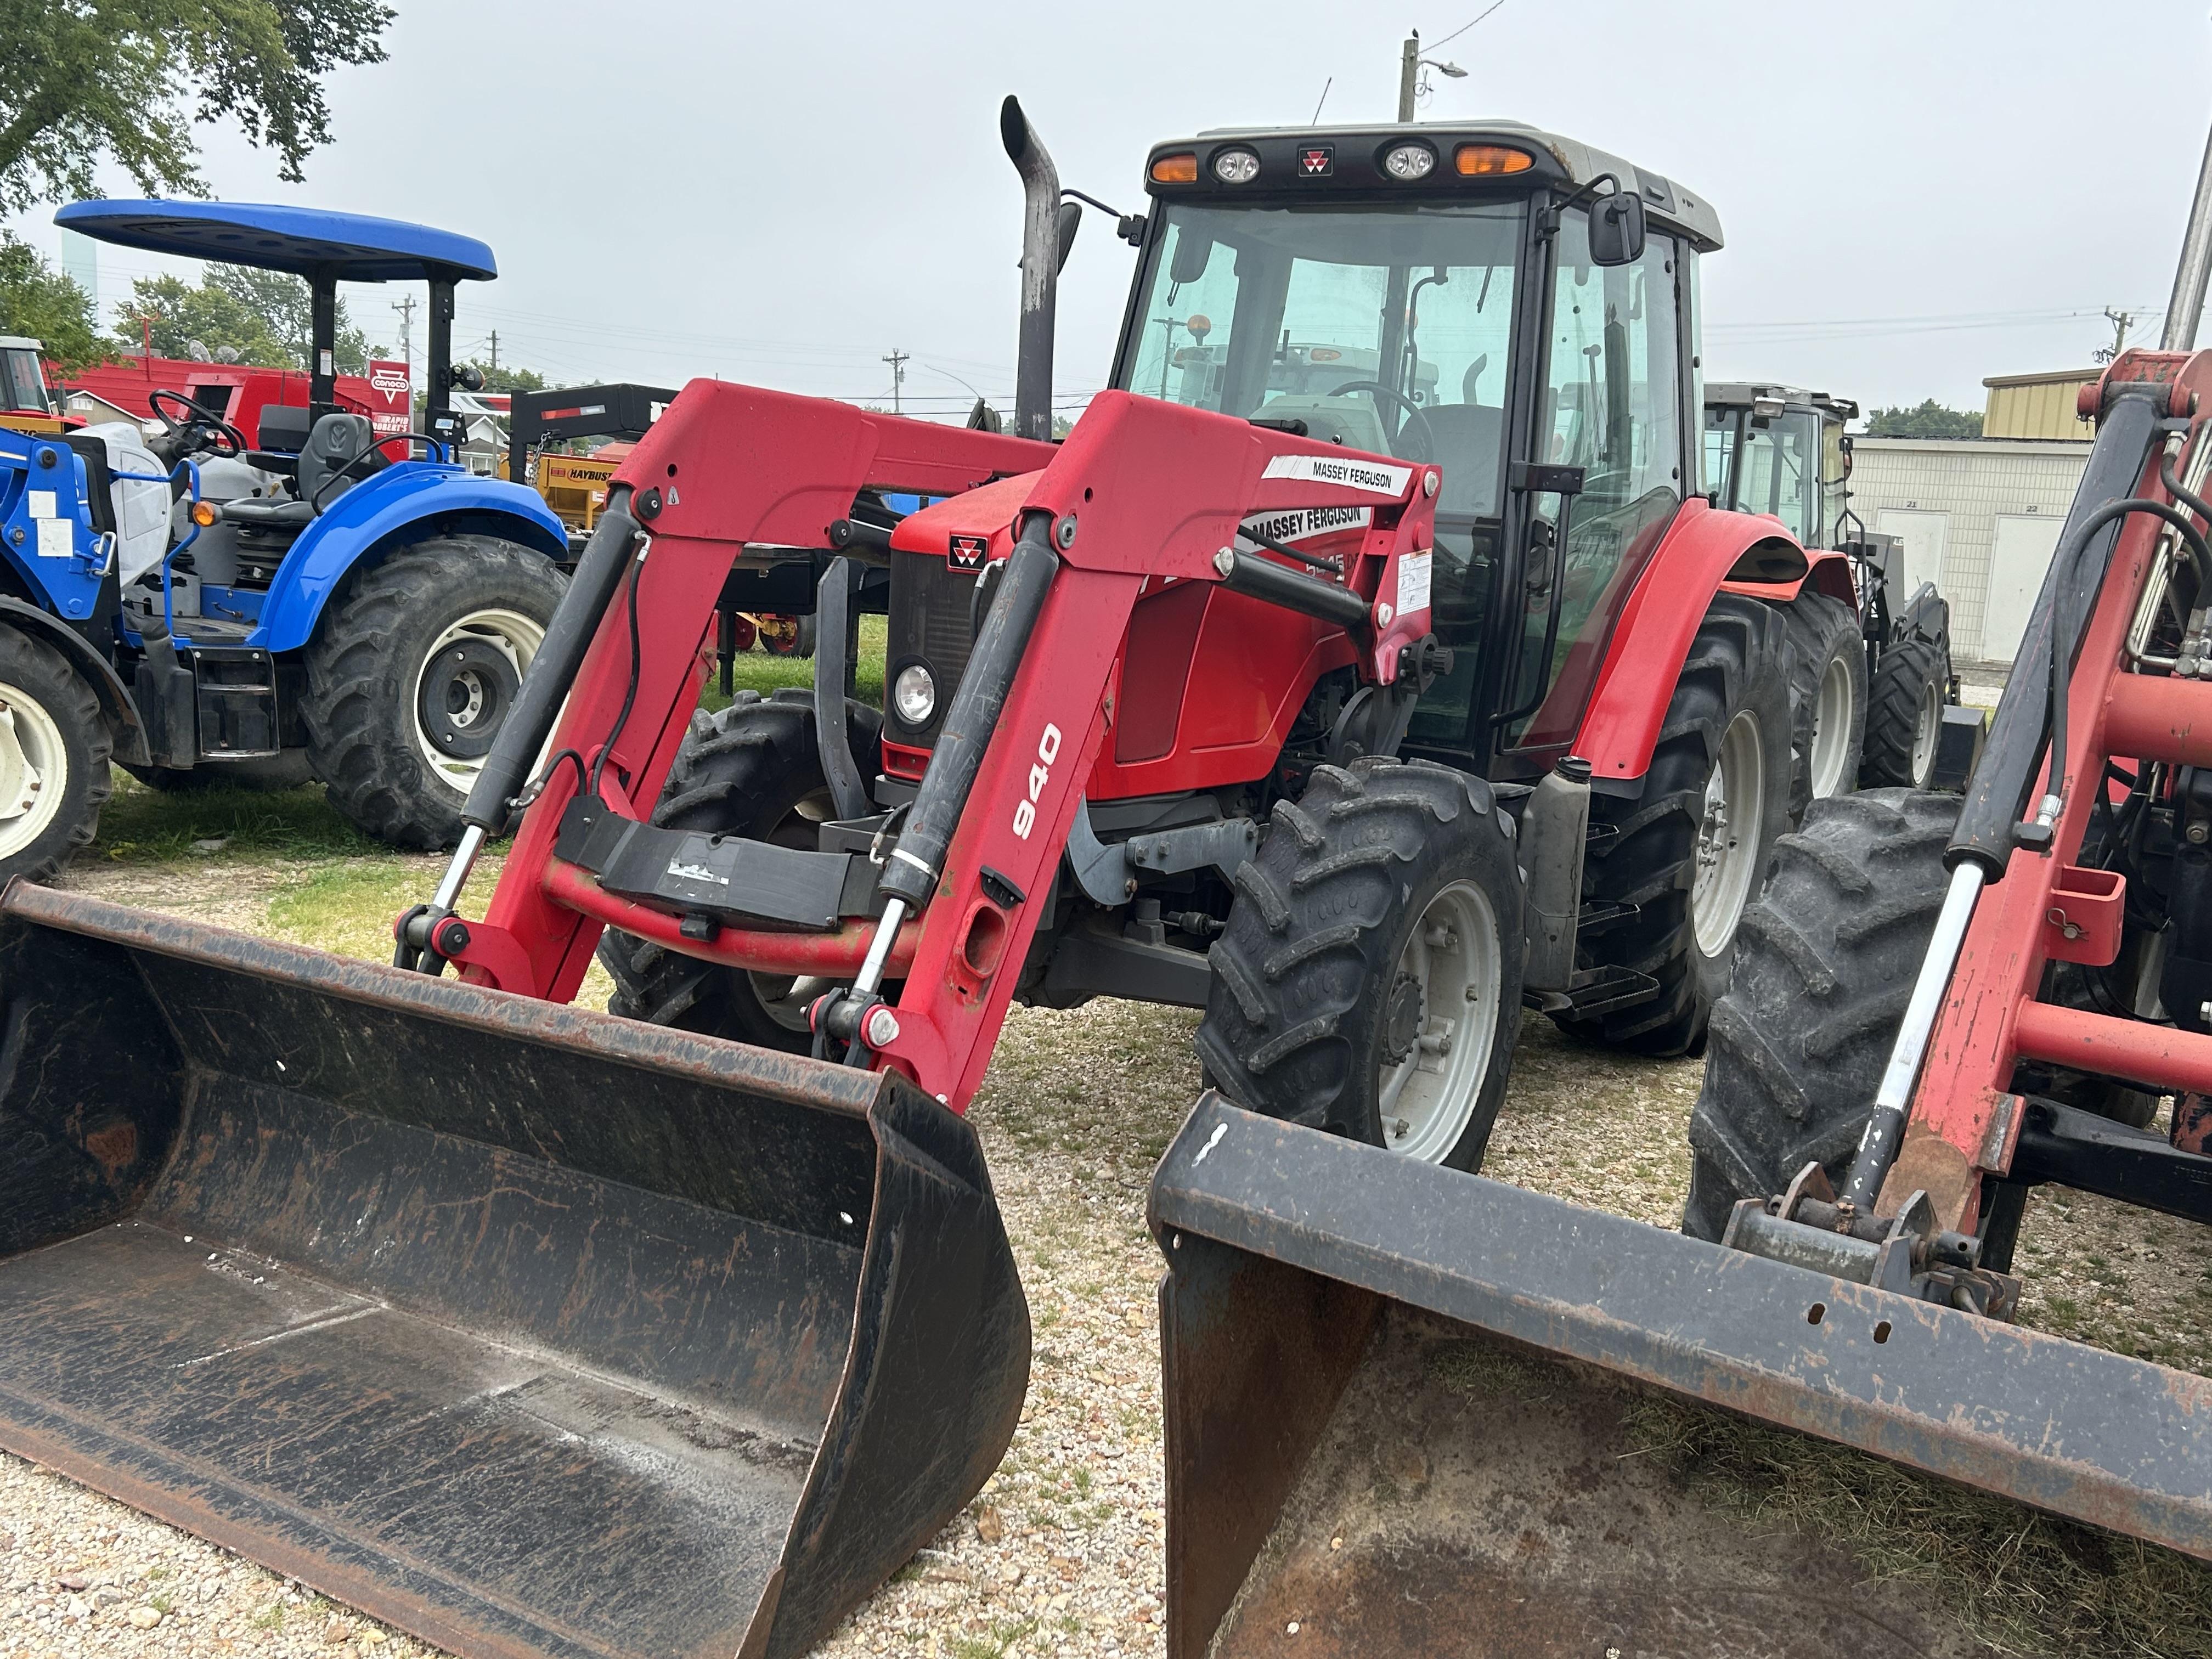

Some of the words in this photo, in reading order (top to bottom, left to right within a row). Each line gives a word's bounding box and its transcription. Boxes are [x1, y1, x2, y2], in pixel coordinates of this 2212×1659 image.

[374, 379, 406, 388] conoco
[386, 416, 409, 425] RAPID
[1313, 461, 1348, 481] MASSEY
[1350, 469, 1392, 488] FERGUSON
[1307, 507, 1361, 531] FERGUSON
[1013, 723, 1062, 840] 940
